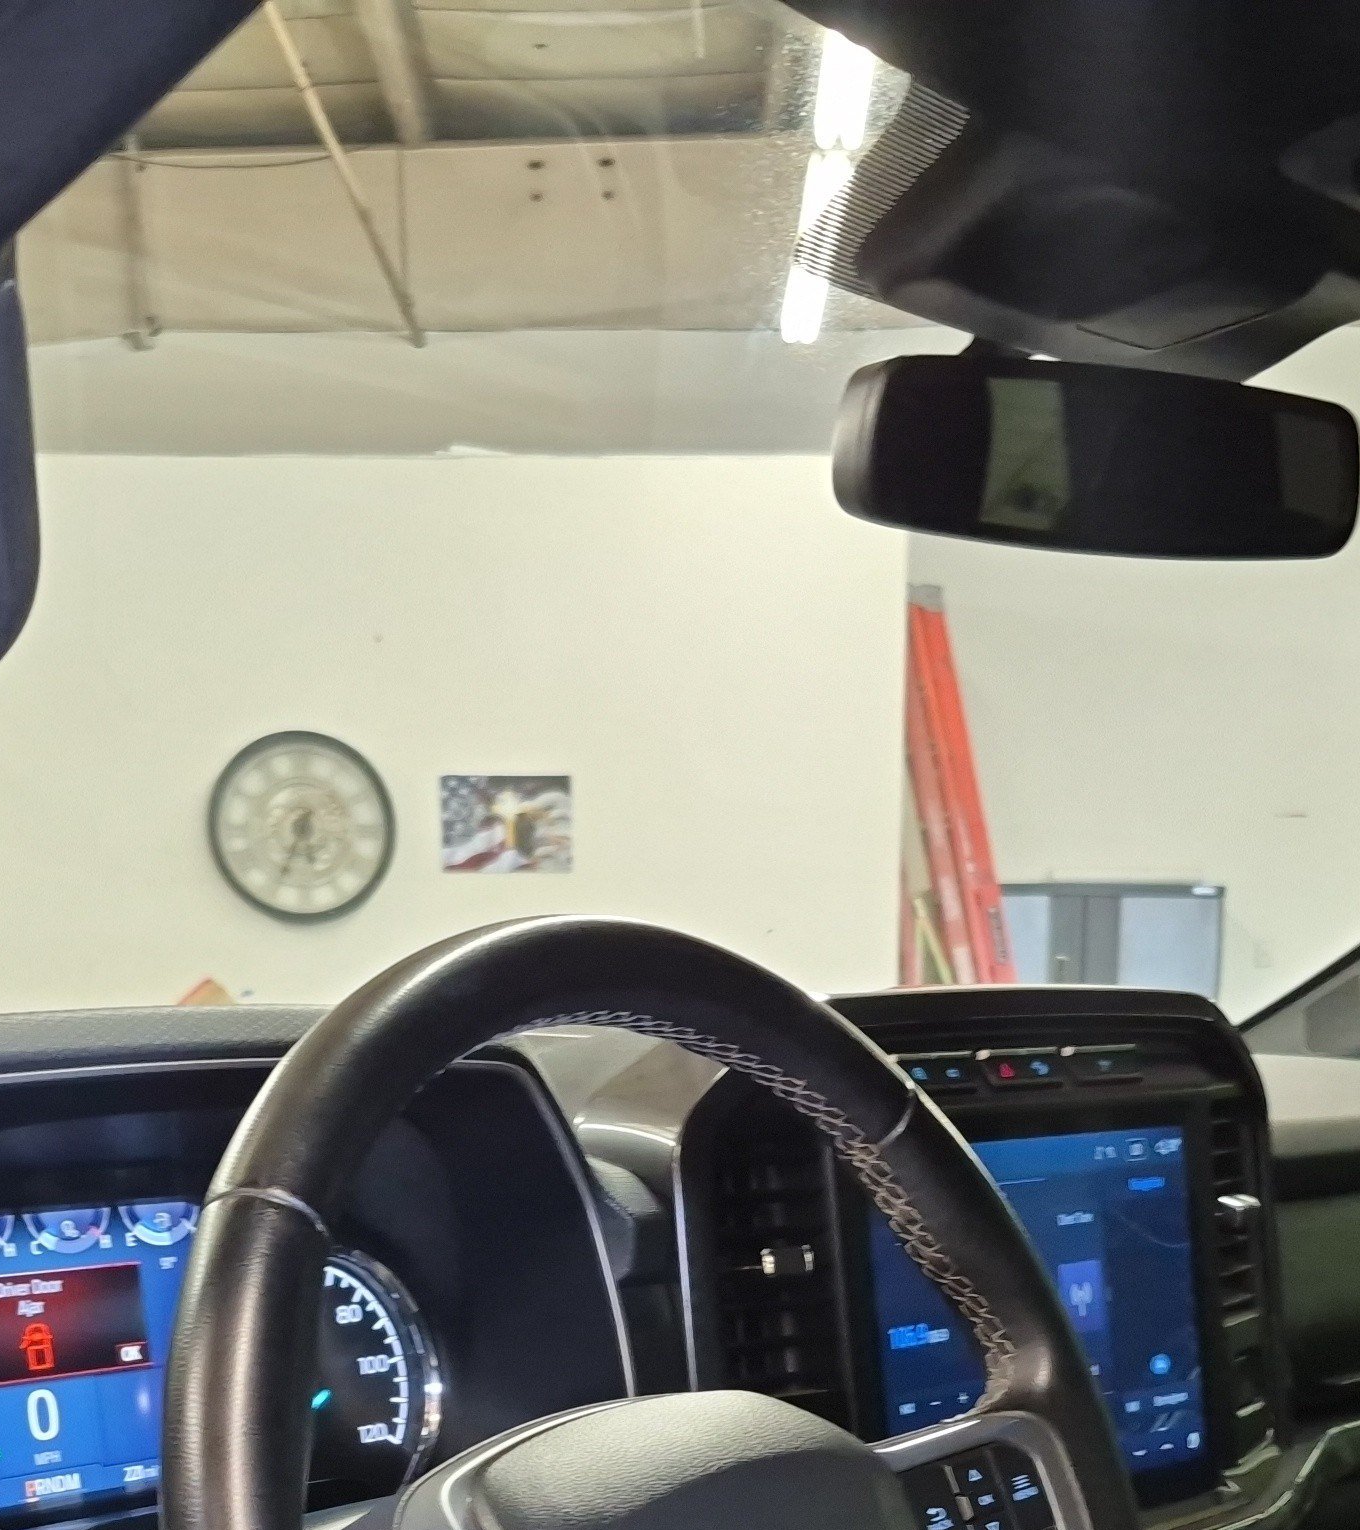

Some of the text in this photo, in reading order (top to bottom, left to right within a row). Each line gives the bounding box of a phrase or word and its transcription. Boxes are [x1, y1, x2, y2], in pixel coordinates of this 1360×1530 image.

[31, 1278, 64, 1295] Door
[335, 1304, 363, 1324] 80
[356, 1354, 390, 1375] 100
[27, 1388, 60, 1441] 0
[357, 1423, 389, 1444] 120
